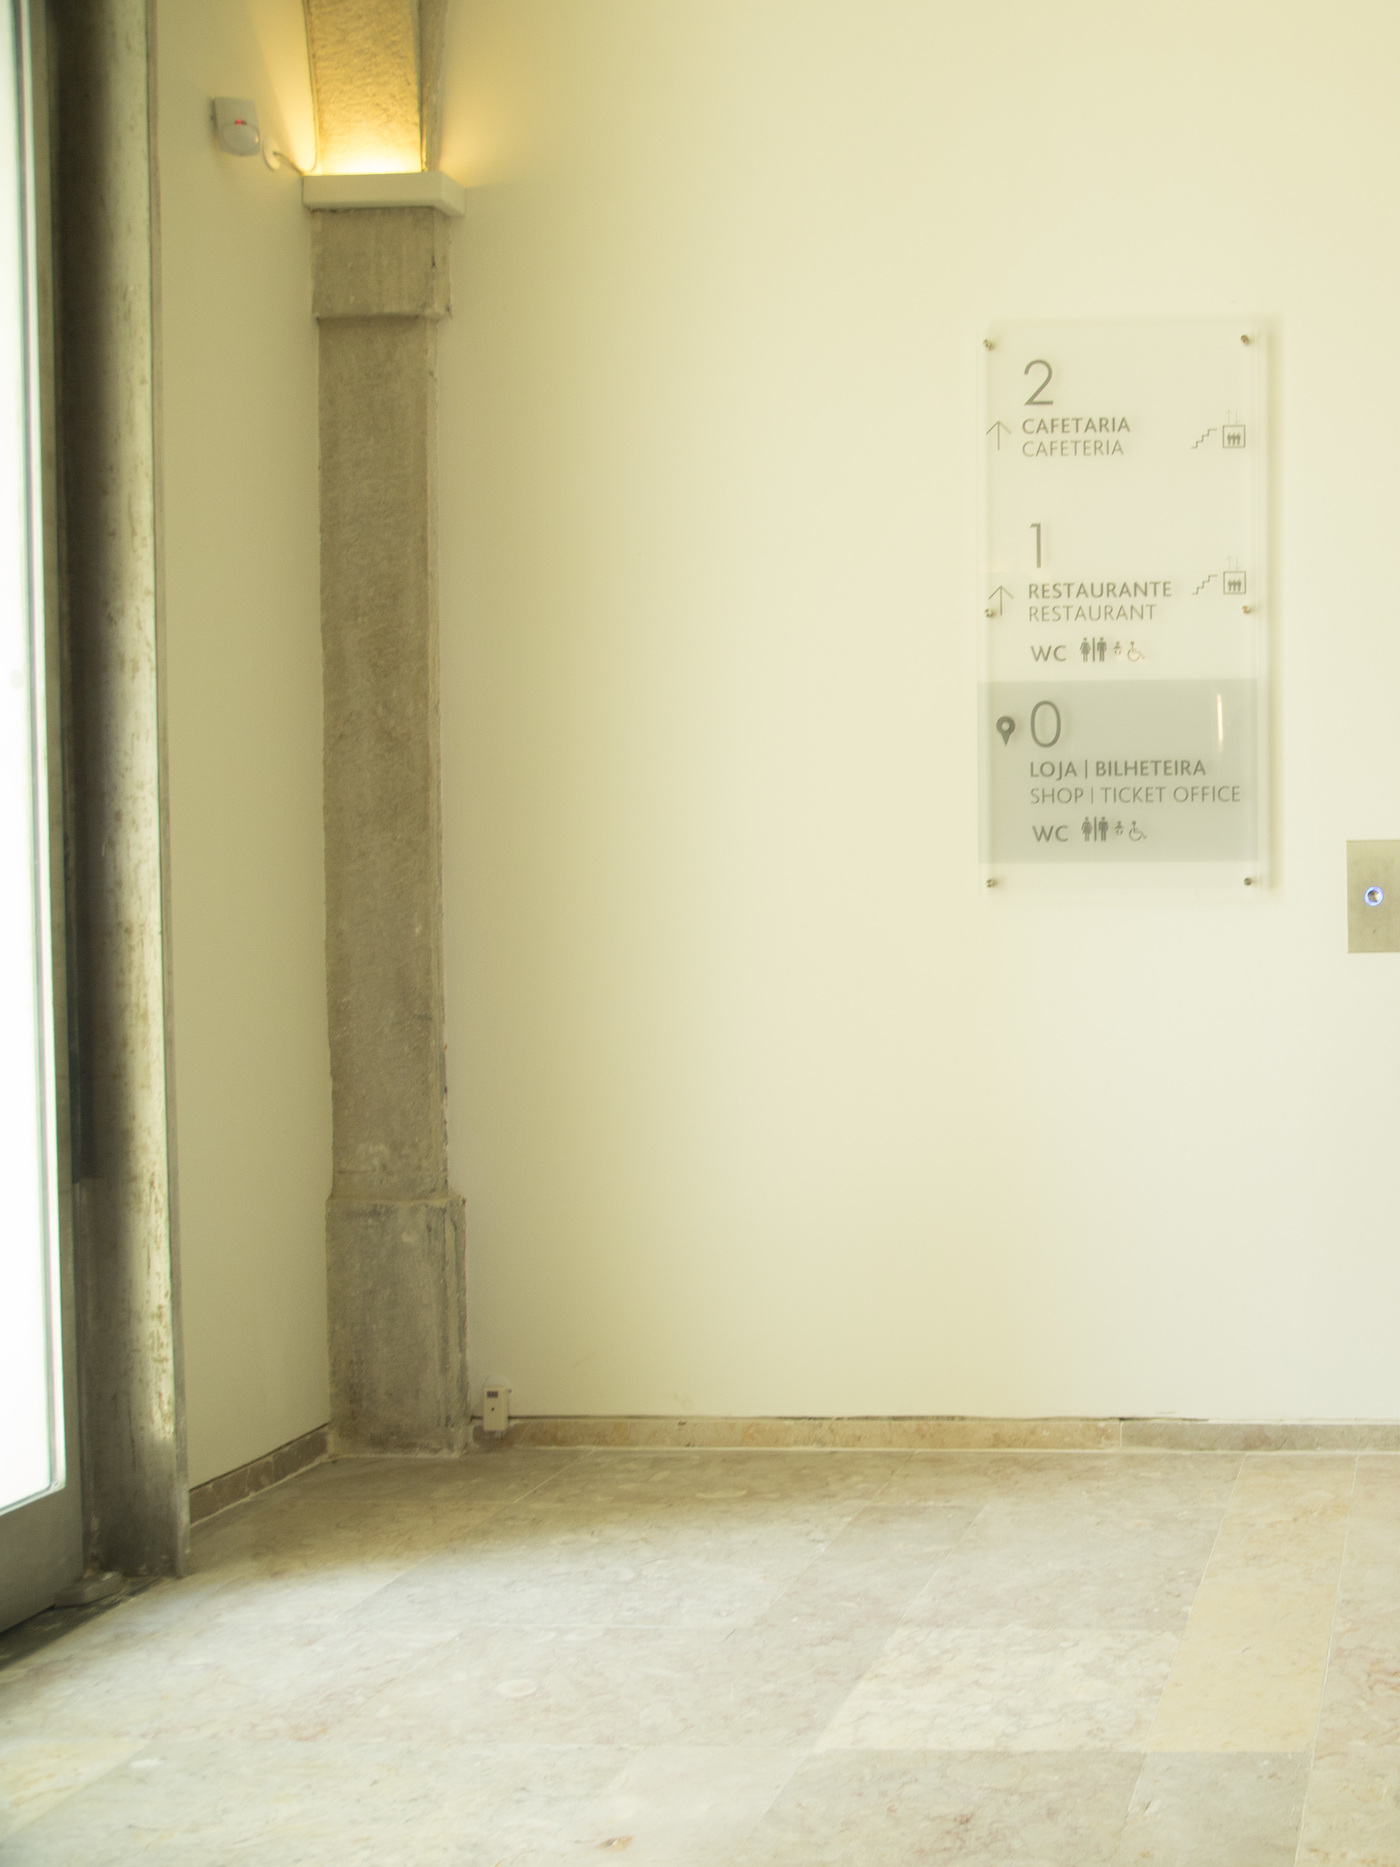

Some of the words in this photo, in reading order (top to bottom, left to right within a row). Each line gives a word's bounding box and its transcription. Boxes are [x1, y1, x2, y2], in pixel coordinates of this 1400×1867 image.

[1023, 359, 1054, 407] 2
[1021, 416, 1131, 435] CAFETARIA
[1021, 439, 1125, 458] CAFETERIA
[1029, 522, 1042, 569] 1
[1028, 580, 1173, 600] RESTAURANTE
[1028, 604, 1157, 623] RESTAURANT
[1030, 644, 1068, 662] WC
[1030, 700, 1062, 748] 0
[1029, 760, 1078, 781] LOJA
[1095, 759, 1207, 778] BILHETEIRA
[1029, 786, 1085, 805] SHOP
[1100, 785, 1167, 804] TICKET
[1173, 785, 1241, 803] OFFICE
[1032, 825, 1069, 842] WC
